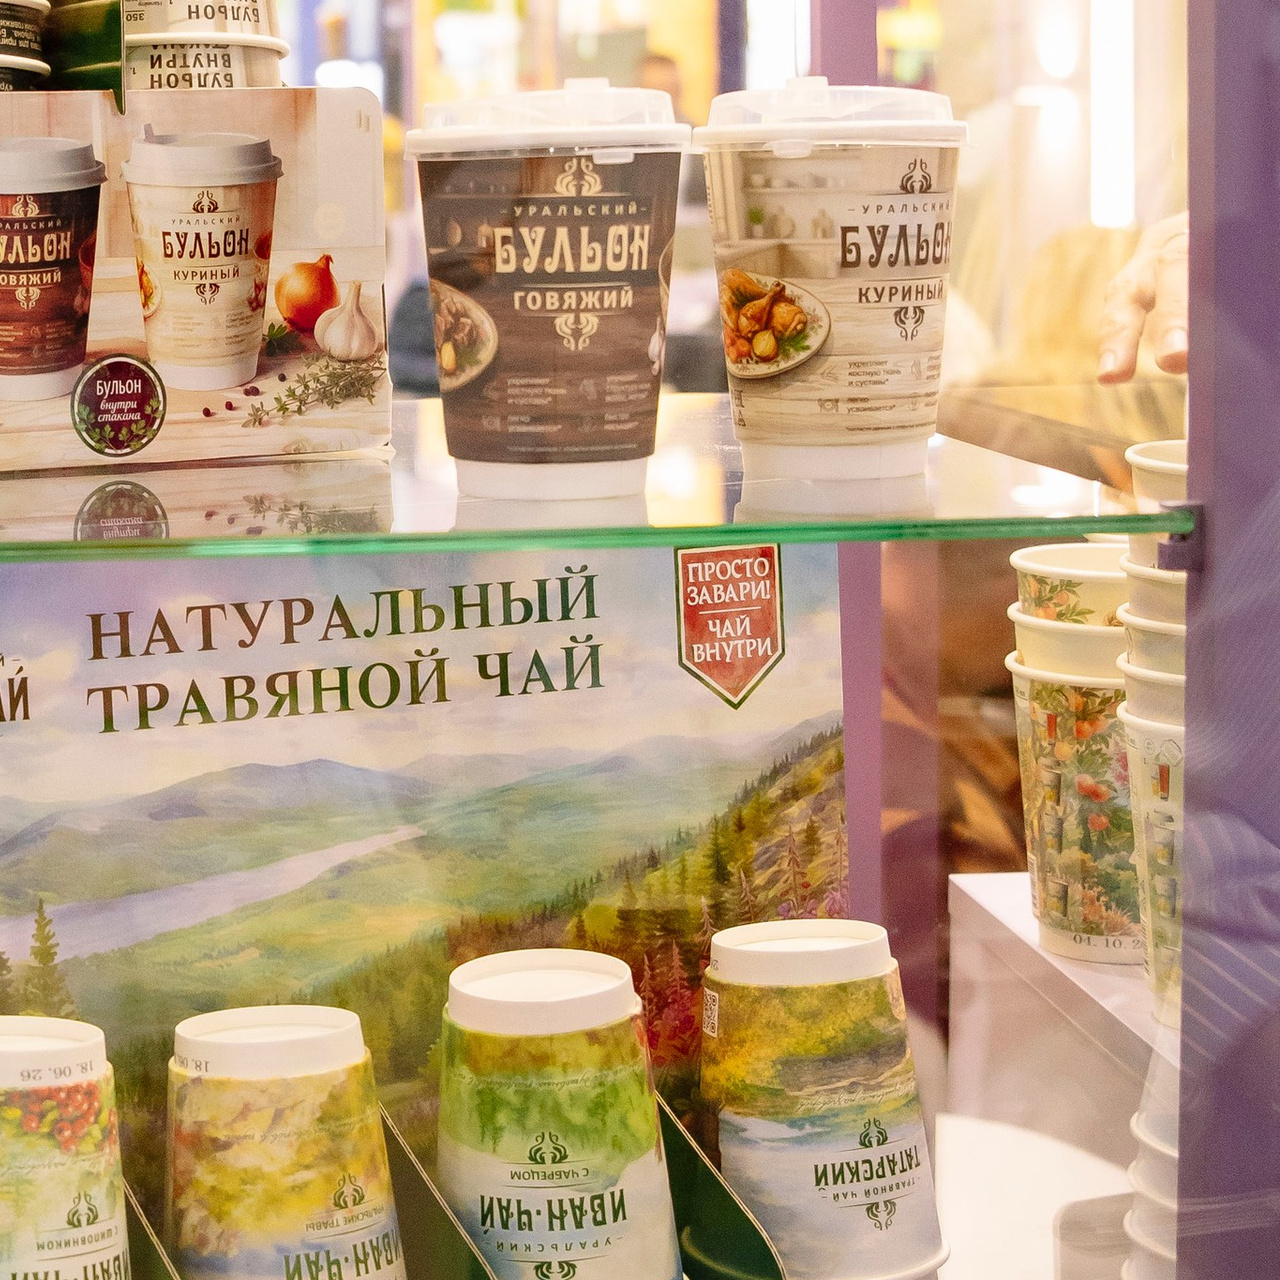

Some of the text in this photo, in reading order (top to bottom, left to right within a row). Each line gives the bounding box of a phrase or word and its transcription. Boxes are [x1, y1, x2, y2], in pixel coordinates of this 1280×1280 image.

[125, 11, 145, 22] 350
[187, 4, 260, 23] БУЛЬОН
[150, 53, 232, 69] ВНУТРИ
[150, 73, 233, 90] БУЛЬОН
[514, 202, 638, 217] УРАЛЬСКИЙ
[162, 228, 249, 259] БУЛЬОН
[494, 224, 650, 274] БУЛЬОН
[174, 266, 240, 280] КУРИНЫЙ
[514, 286, 633, 311] ГОВЯЖИЙ
[858, 282, 944, 303] КУРИНЫЙ
[96, 379, 142, 399] БУЛЬОН
[98, 412, 141, 422] стакана
[100, 400, 137, 413] внутри
[687, 557, 770, 584] ПРОСТО
[686, 580, 771, 606] ЗАВАРИ!
[86, 564, 601, 661] НАТУРАЛЬНЫЙ
[708, 615, 751, 640] ЧАЙ
[691, 638, 773, 664] ВНУТРИ
[87, 633, 605, 735] ТРАВЯНОЙ ЧАЙ
[510, 1168, 589, 1180] С ЧАБРЕЦОМ
[814, 1145, 921, 1191] ТАТАРСКИЙ
[833, 1178, 916, 1202] ТРАВЯНОЙ ЧАЙ
[305, 1219, 340, 1232] ТРАВЫ
[36, 1228, 113, 1251] ШИПОВНИКОМ
[496, 1237, 611, 1253] УРАЛЬСКИЙ
